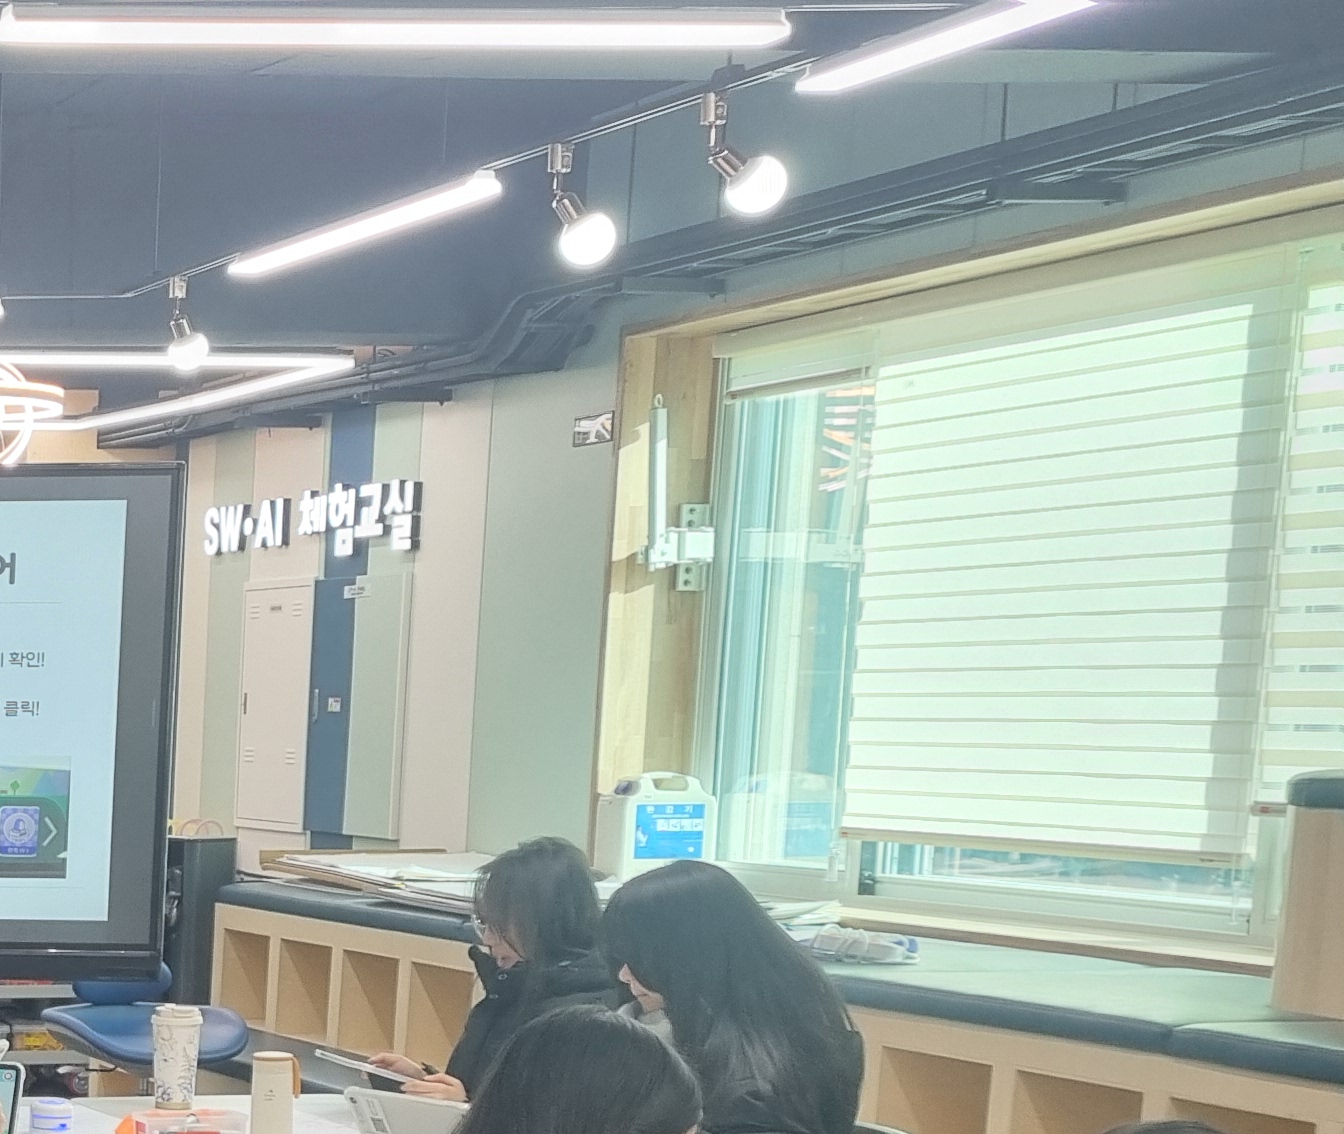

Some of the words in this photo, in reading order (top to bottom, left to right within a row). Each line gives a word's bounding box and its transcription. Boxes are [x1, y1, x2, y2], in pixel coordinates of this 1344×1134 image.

[297, 478, 418, 557] 체험교실
[7, 651, 46, 668] 확인!
[3, 700, 41, 717] 클릭!
